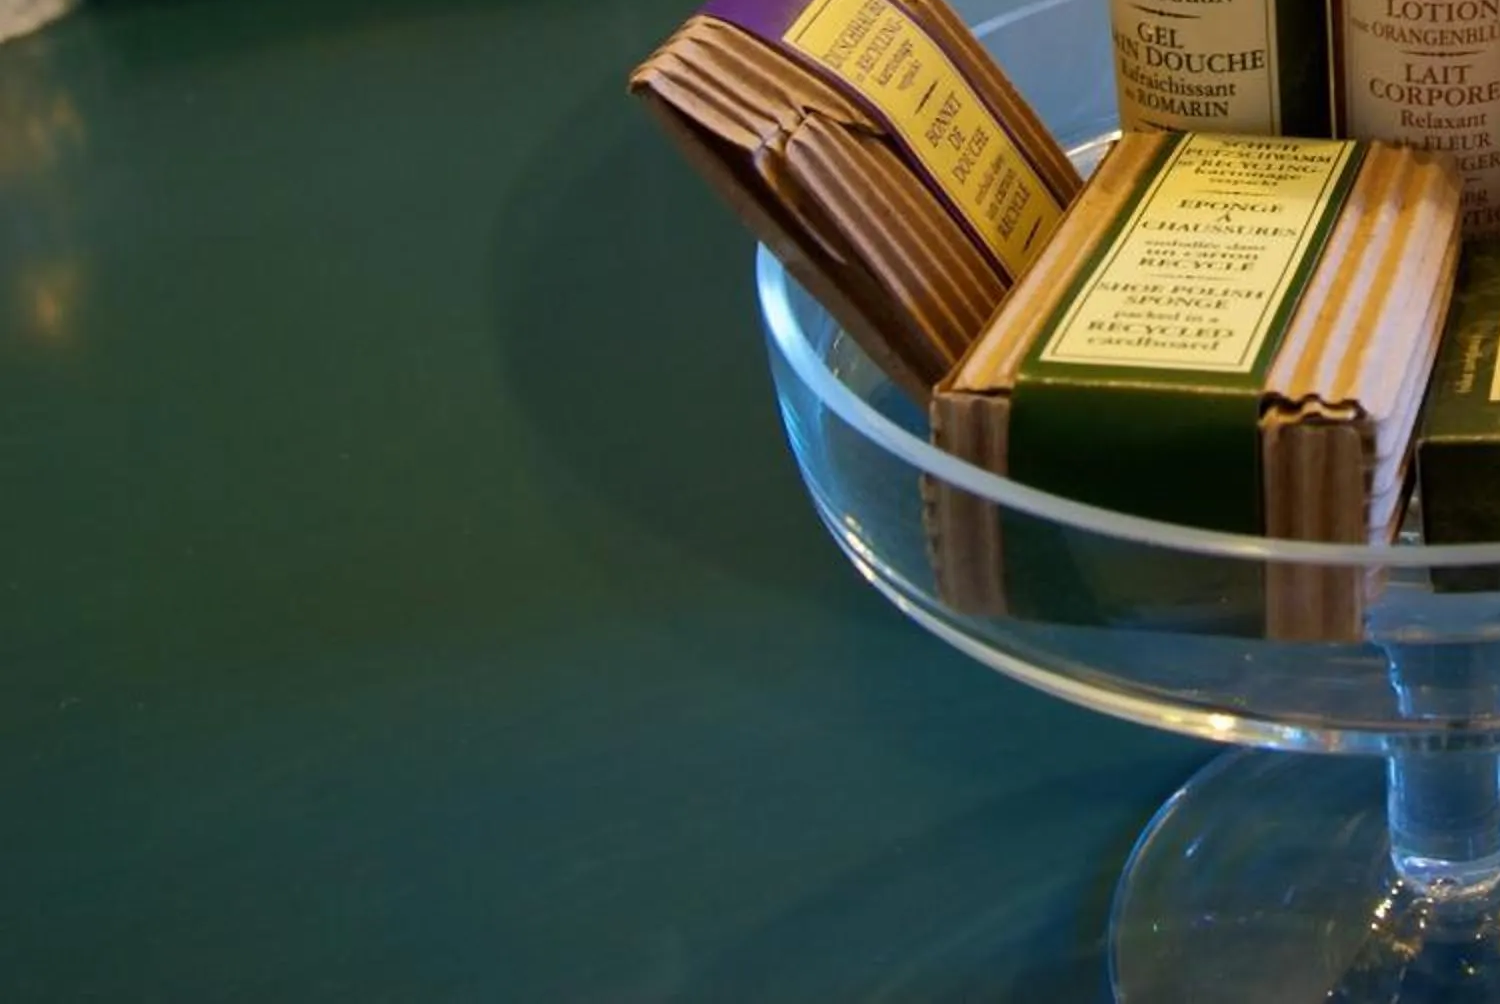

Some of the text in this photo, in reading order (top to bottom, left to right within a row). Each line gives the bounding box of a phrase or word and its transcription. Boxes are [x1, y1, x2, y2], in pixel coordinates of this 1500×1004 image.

[1137, 21, 1184, 49] GEL
[1146, 46, 1266, 74] DOUCHE
[1404, 63, 1473, 84] LAIT
[1137, 88, 1230, 118] ROMARIN
[1401, 109, 1488, 130] Relaxant
[948, 126, 966, 151] DE
[1141, 219, 1298, 238] CHAUSSURES
[1096, 281, 1265, 299] SHOE POLISH
[1125, 295, 1229, 310] SPONGE
[1087, 321, 1235, 339] RECYCLED
